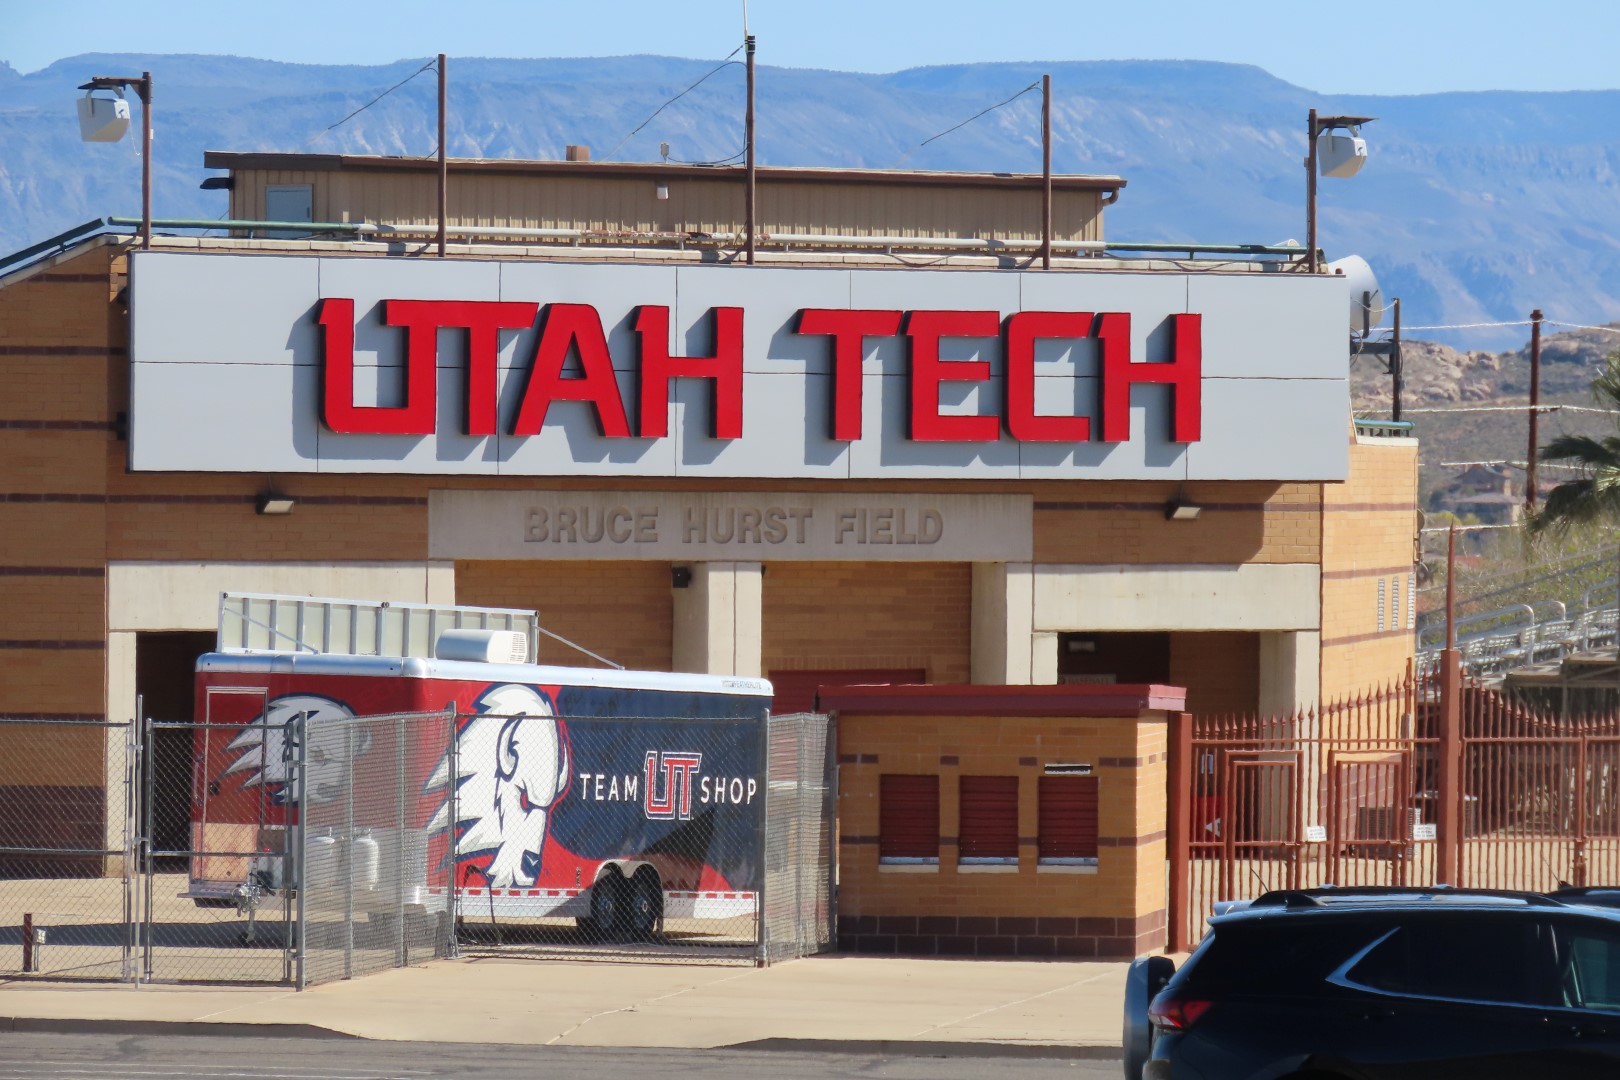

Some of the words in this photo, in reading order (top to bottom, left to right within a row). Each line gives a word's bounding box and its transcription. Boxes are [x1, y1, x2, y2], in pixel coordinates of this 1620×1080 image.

[314, 298, 745, 439] UTAH
[792, 308, 1202, 442] TECH
[523, 505, 659, 544] BRUCE
[682, 506, 813, 545] HURST
[834, 507, 944, 546] FIELD
[580, 773, 638, 802] TEAM
[644, 750, 702, 821] UT
[700, 776, 757, 805] SHOP
